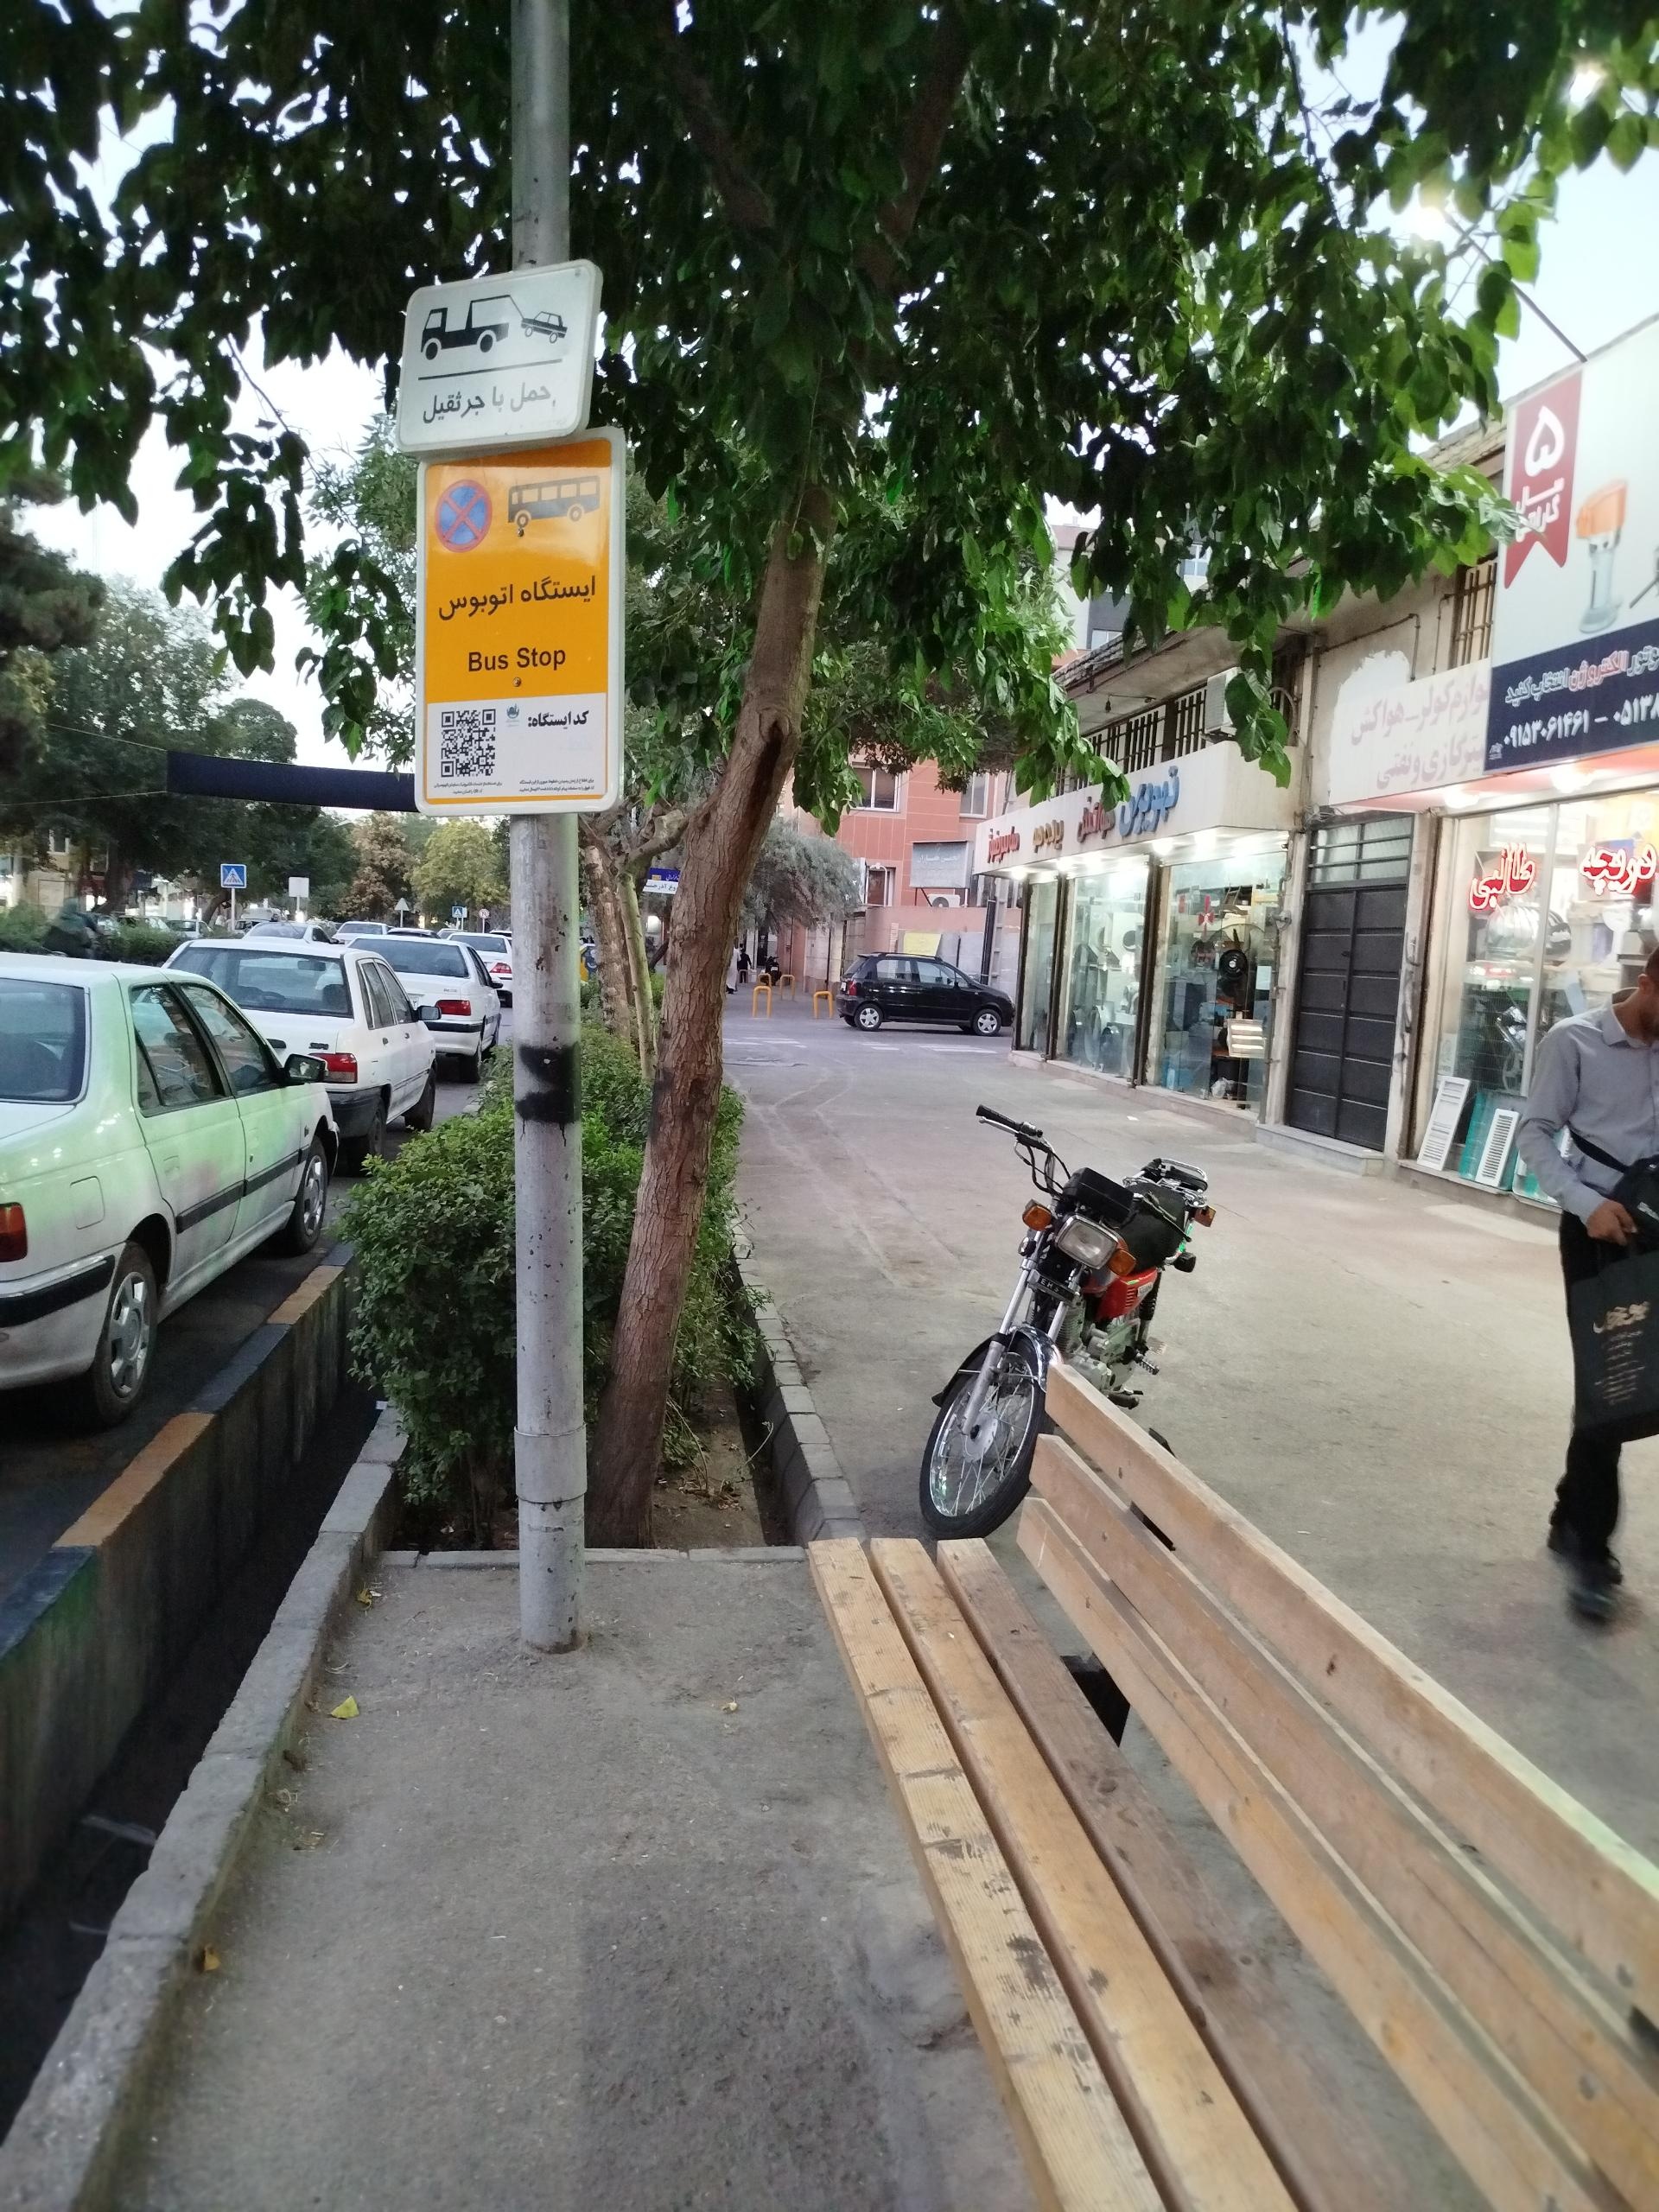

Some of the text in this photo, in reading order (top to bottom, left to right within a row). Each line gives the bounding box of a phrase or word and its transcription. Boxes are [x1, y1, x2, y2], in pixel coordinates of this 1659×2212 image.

[423, 382, 551, 424] حمل با جرثقیل
[1524, 405, 1565, 477] ۵
[439, 575, 595, 620] ایستگاه اتوبوس
[468, 647, 566, 671] Bus Stop
[1504, 676, 1533, 708] کنید
[1531, 667, 1570, 702] انتخاب
[528, 711, 571, 729] ایستگاه:
[574, 710, 589, 726] کد
[1351, 699, 1403, 745] هواکش
[1417, 682, 1453, 731] کولر
[1503, 709, 1590, 748] ۰۹۱۵۳۰۶۱۴۶۱
[1469, 842, 1658, 911] دریچه طالبی
